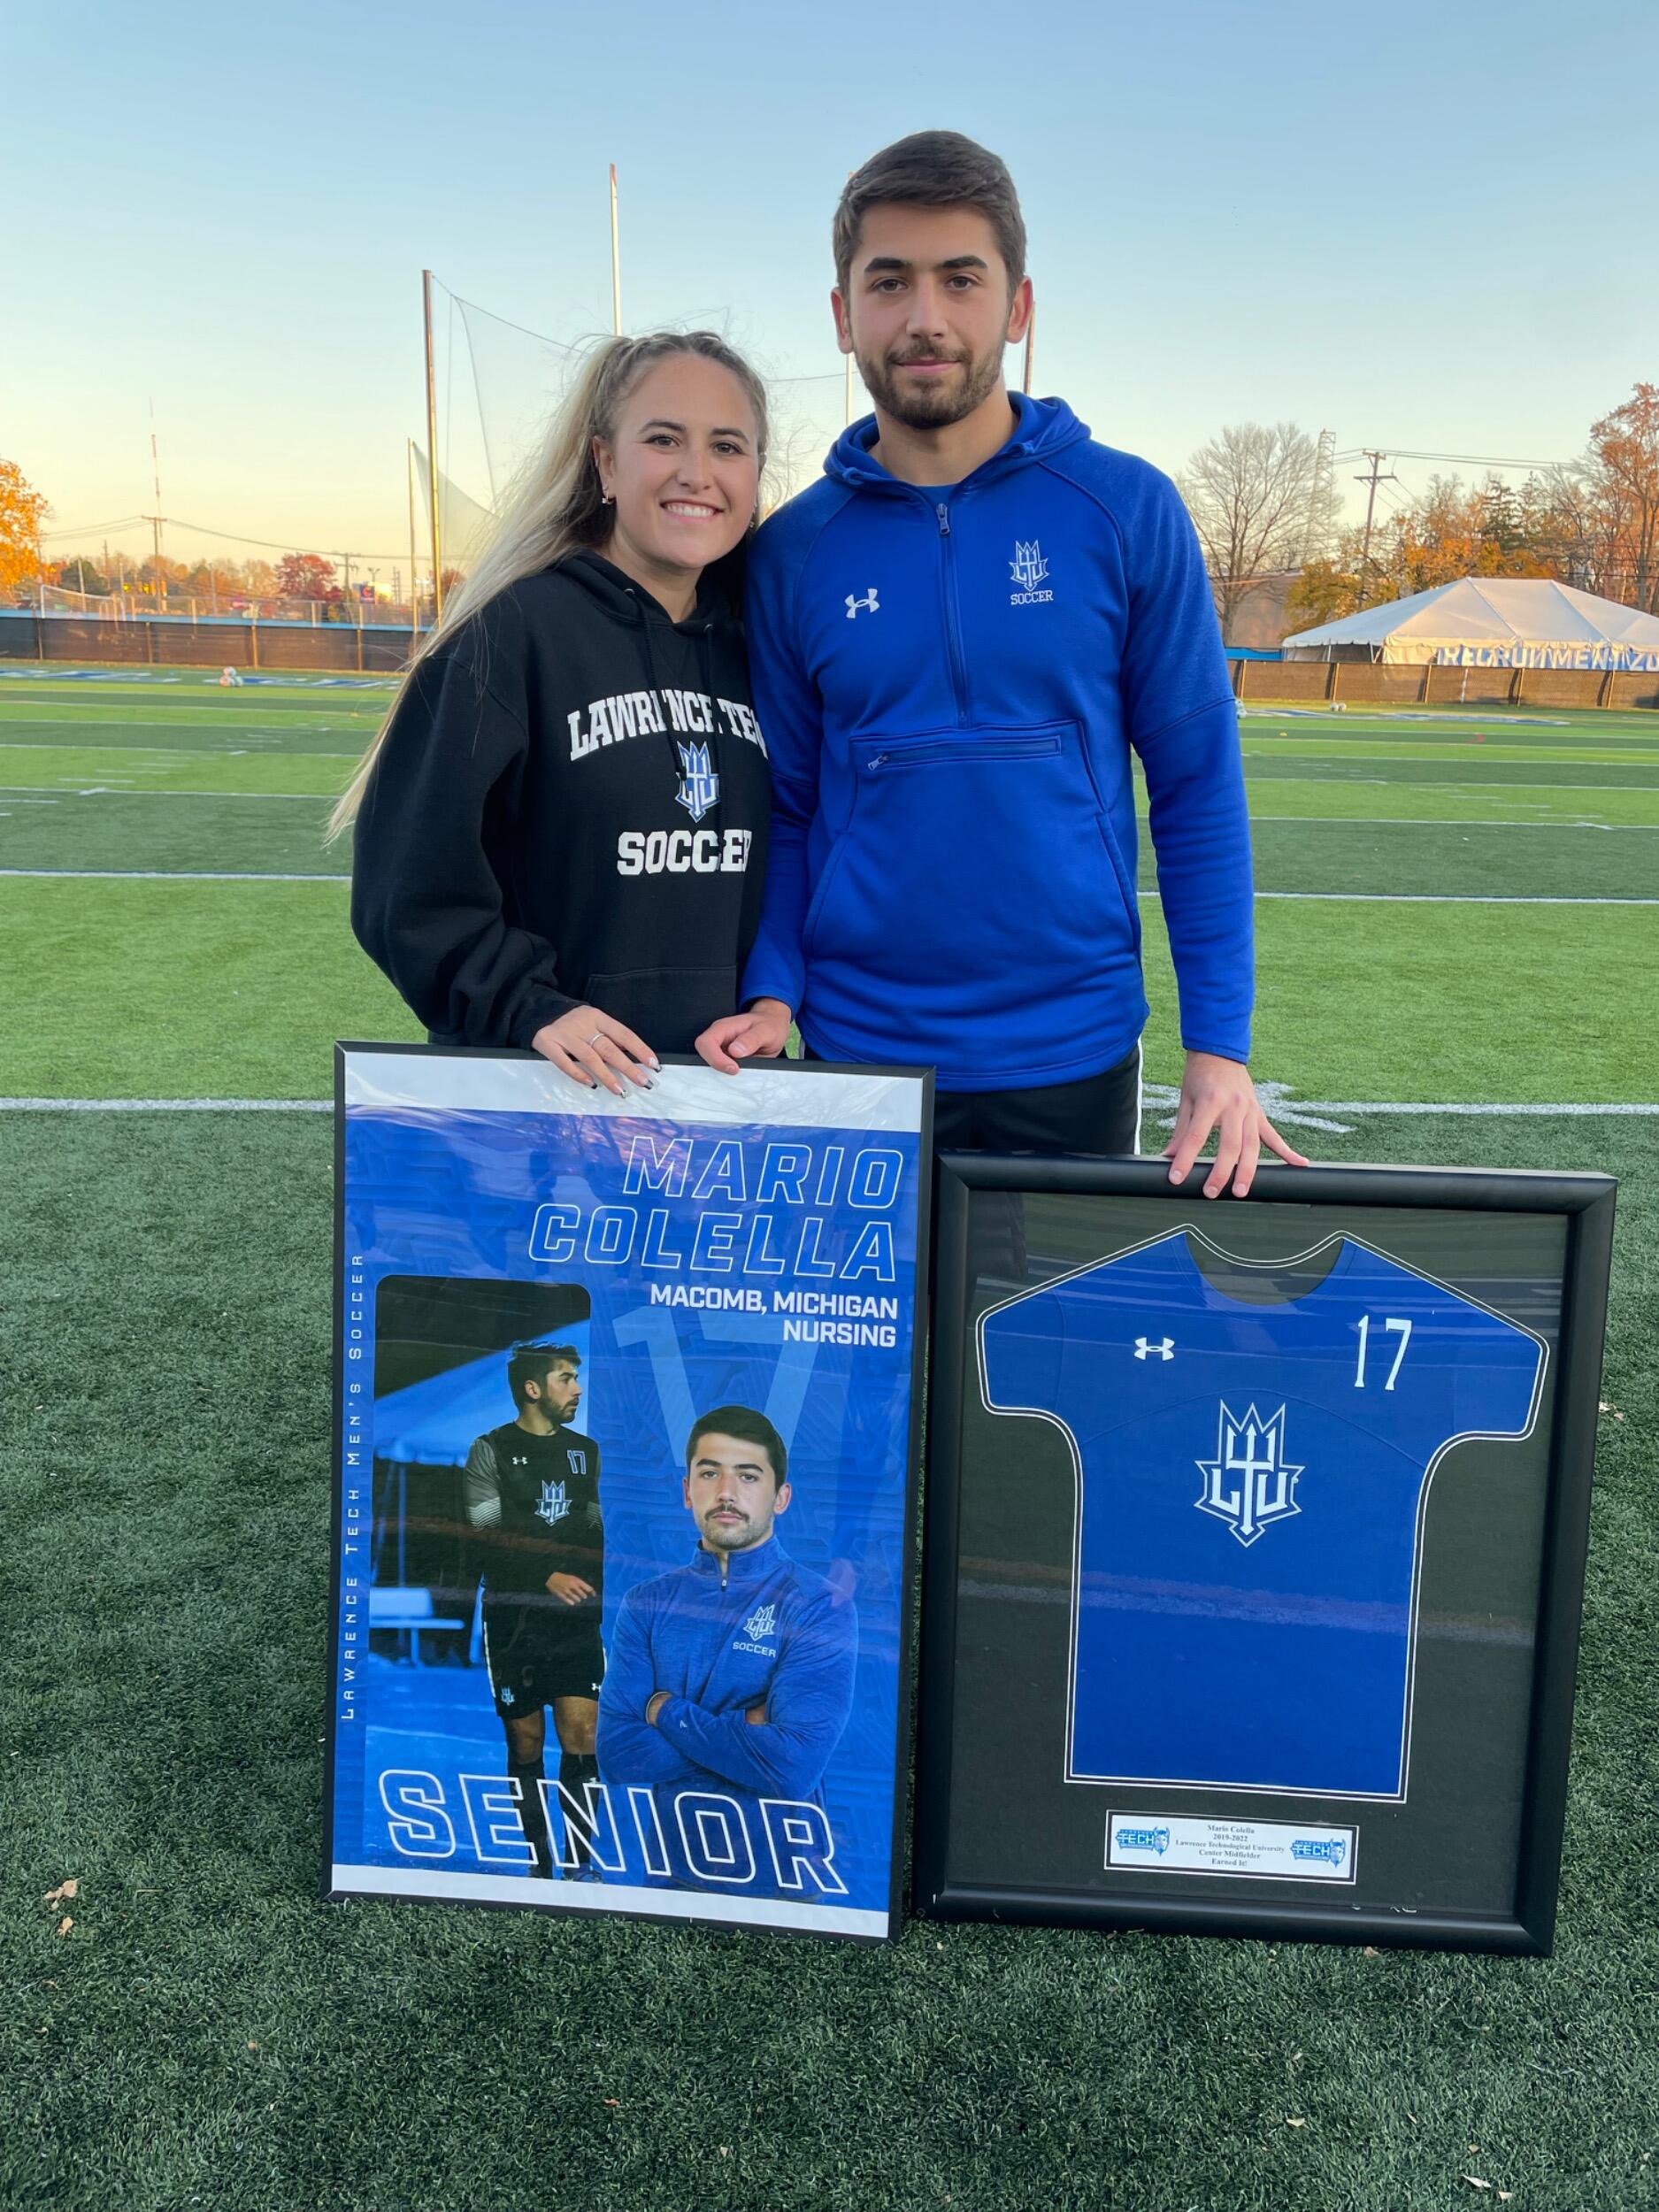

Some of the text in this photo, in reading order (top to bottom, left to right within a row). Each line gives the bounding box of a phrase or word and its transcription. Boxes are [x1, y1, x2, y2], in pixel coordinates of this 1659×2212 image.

[1010, 590, 1054, 605] SOCCER
[623, 1136, 902, 1209] MARIO
[528, 1203, 896, 1282] COLELLA
[650, 1284, 897, 1319] MACOMB, MICHIGAN
[783, 1319, 896, 1348] NURSING
[1355, 1315, 1412, 1391] 17
[567, 1449, 587, 1474] 17
[342, 1256, 363, 1719] LAWRENCE TECH MEN'S SOCCER
[733, 1641, 776, 1658] SOCCER
[379, 1770, 849, 1894] SENIOR
[1213, 1833, 1248, 1842] 2019-2022
[1231, 1825, 1255, 1834] Colella
[1209, 1841, 1251, 1851] Technological
[1252, 1845, 1285, 1854] University
[1225, 1850, 1261, 1859] Midfielder
